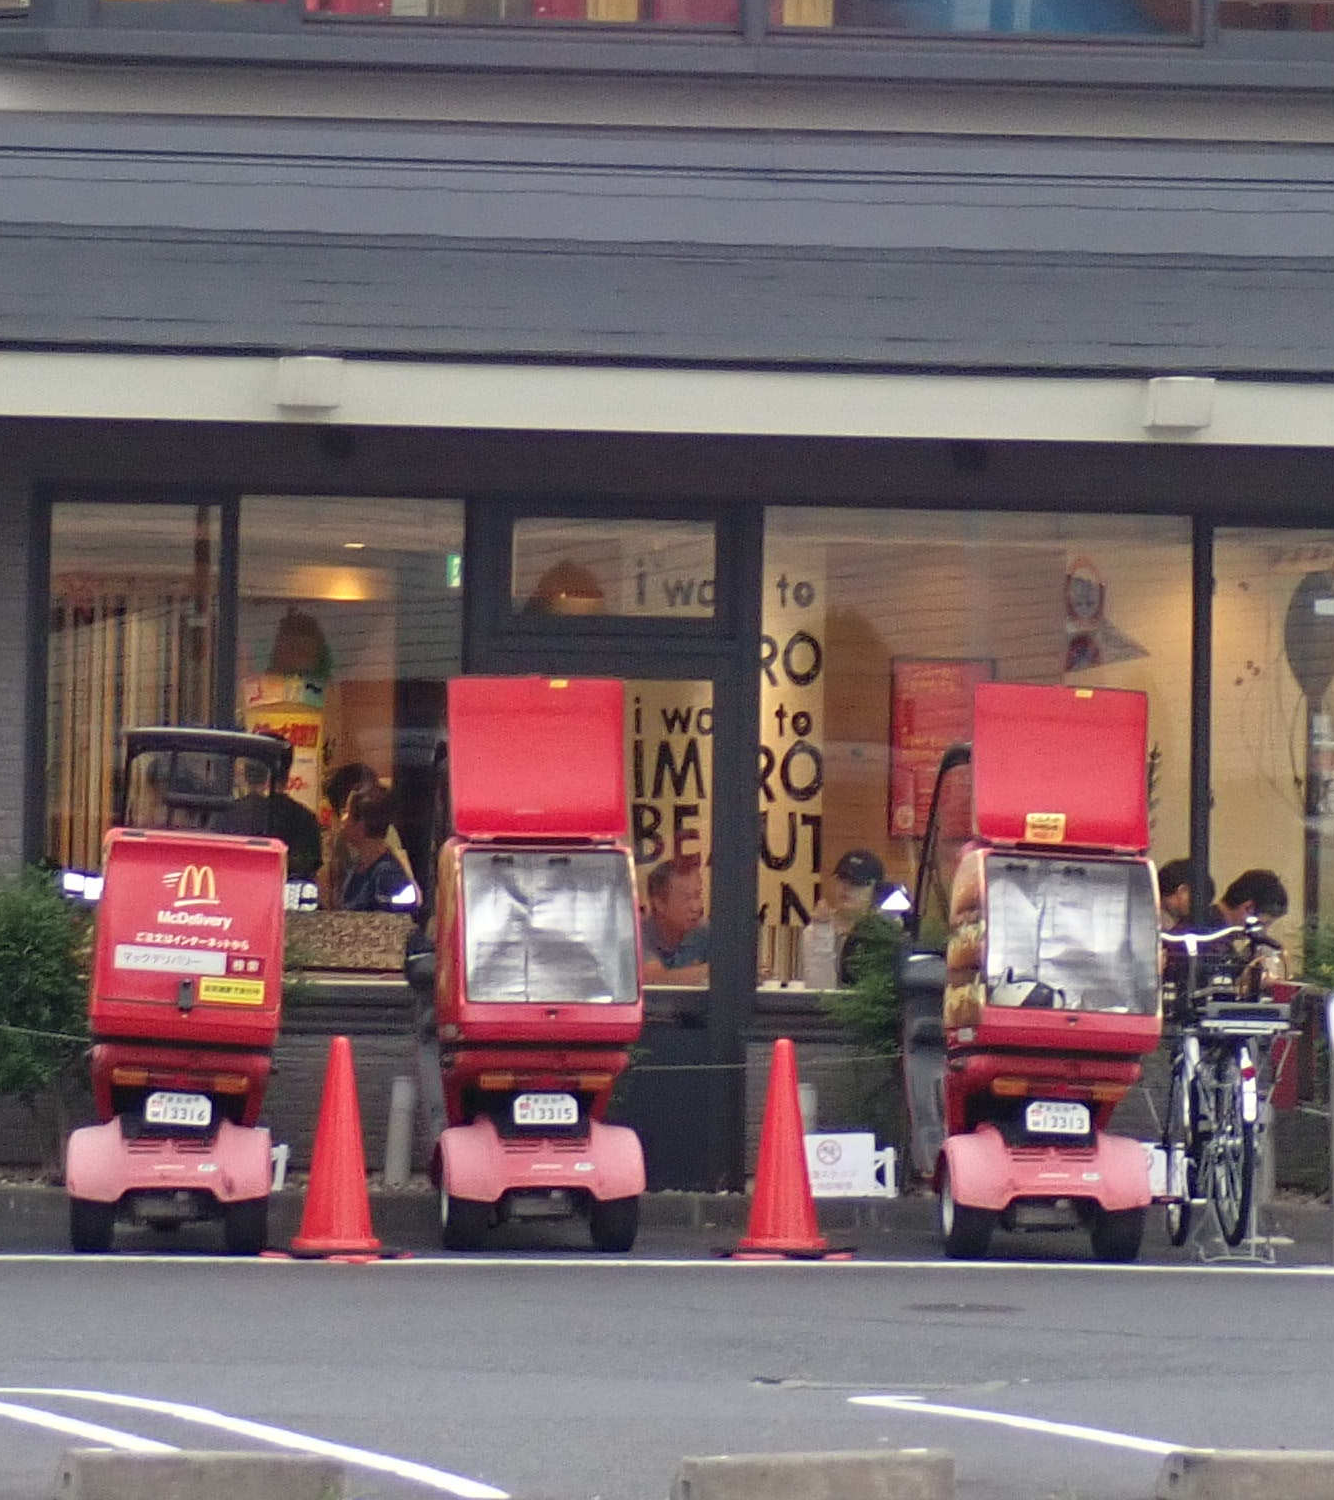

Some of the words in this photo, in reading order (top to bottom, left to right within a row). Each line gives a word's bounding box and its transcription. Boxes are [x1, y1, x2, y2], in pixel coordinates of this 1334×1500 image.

[776, 573, 815, 608] to
[775, 703, 814, 737] to
[157, 910, 233, 931] McDelivery
[123, 951, 204, 966] マックデリバリー
[162, 1106, 206, 1121] 13316
[531, 1107, 573, 1120] 13315
[1043, 1116, 1085, 1130] 13313
